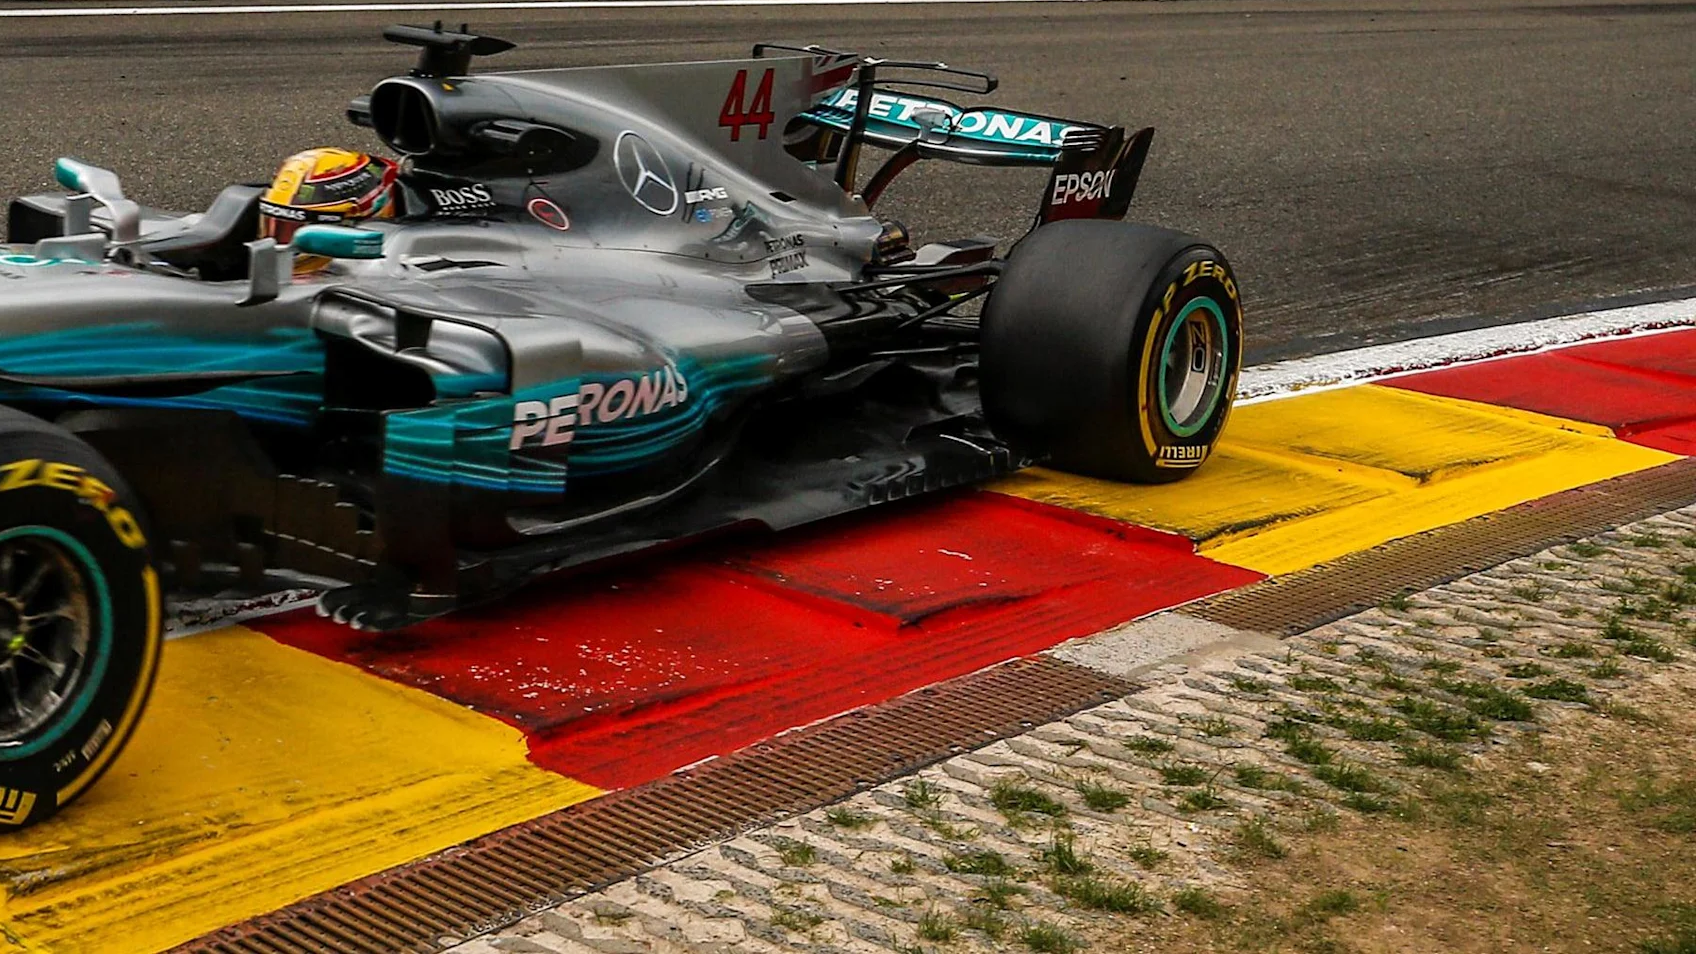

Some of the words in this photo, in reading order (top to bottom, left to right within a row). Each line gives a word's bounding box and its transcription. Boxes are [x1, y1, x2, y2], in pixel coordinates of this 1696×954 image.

[719, 68, 775, 142] 44
[429, 183, 491, 206] BOSS
[1051, 169, 1116, 205] EPSON
[1183, 260, 1238, 301] ZERO
